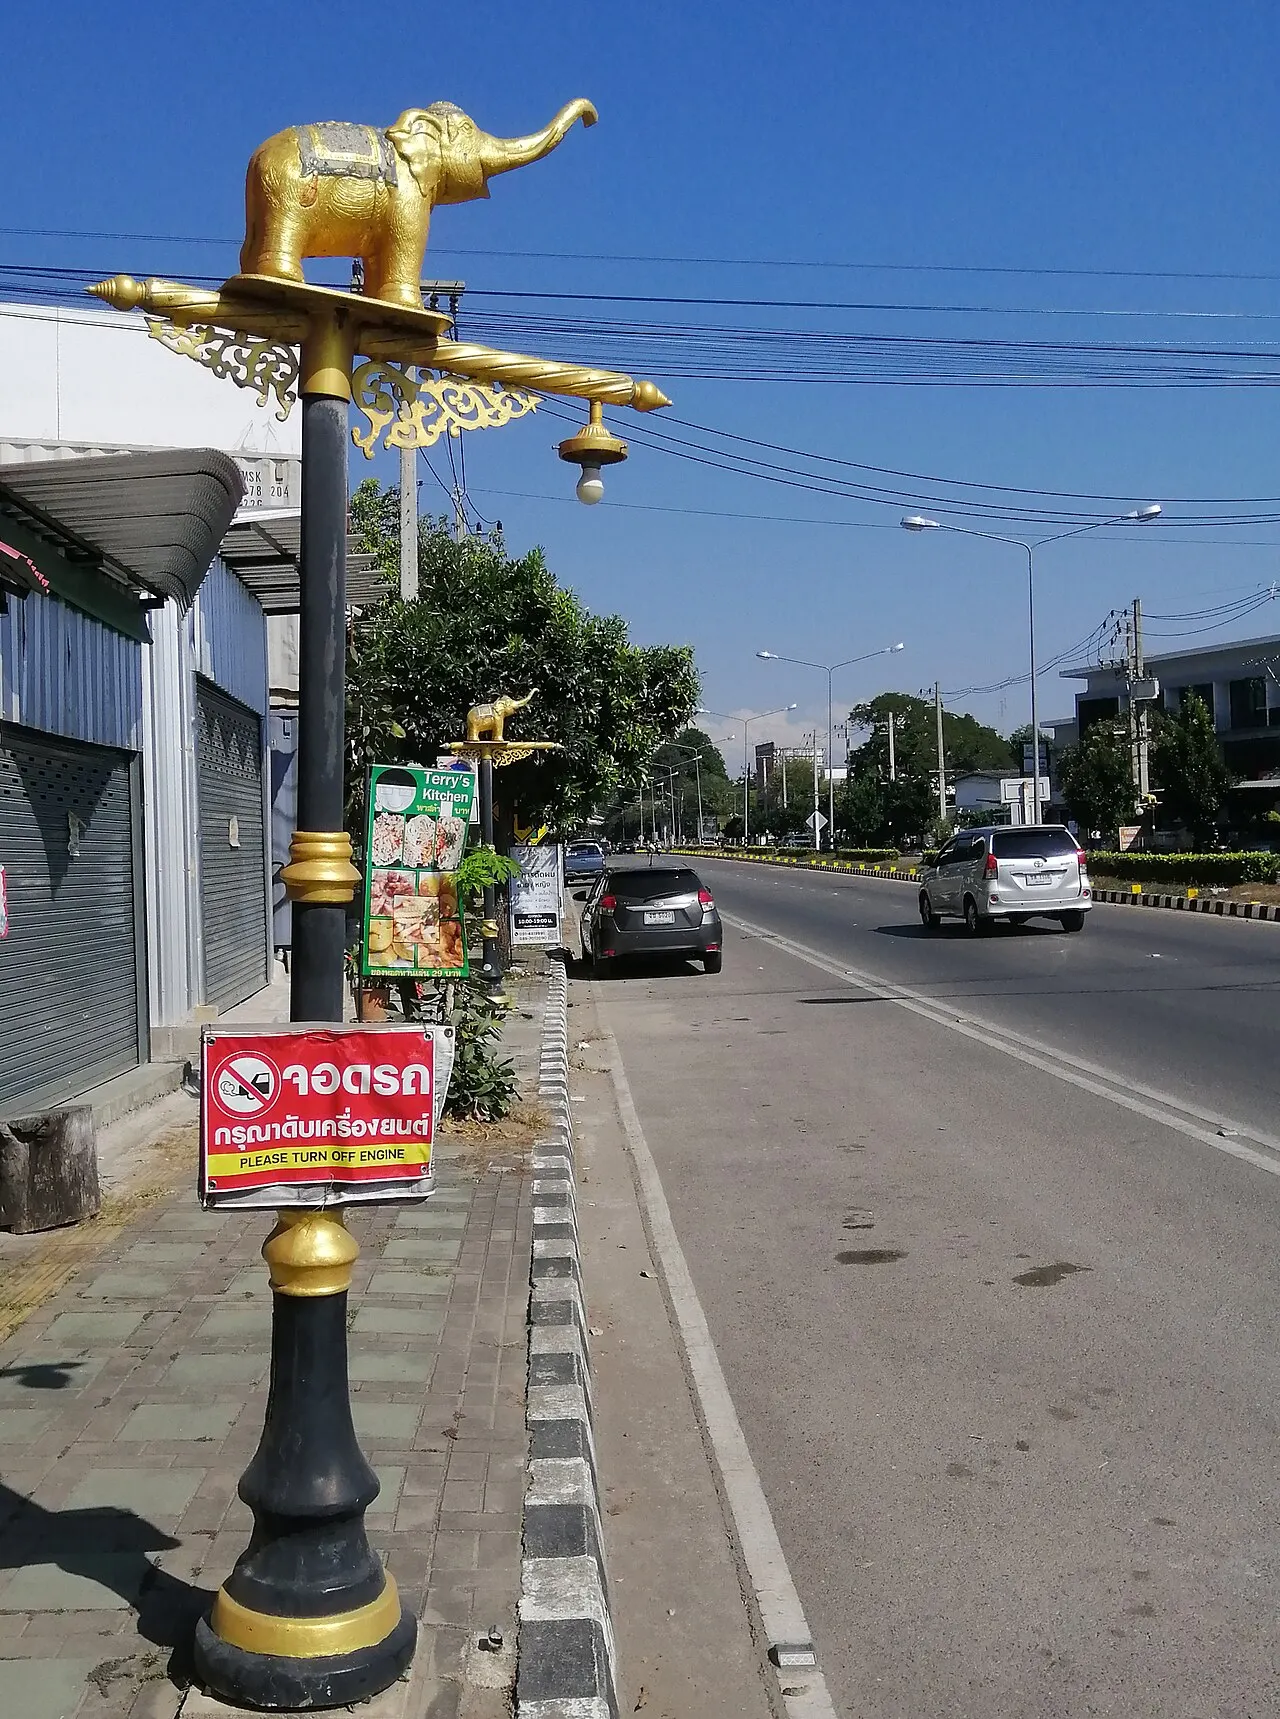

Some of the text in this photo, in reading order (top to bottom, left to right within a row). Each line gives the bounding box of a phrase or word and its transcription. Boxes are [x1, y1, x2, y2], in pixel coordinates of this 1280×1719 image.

[271, 486, 288, 498] 204
[423, 771, 470, 789] Terry's
[422, 788, 469, 803] Kitchen
[432, 969, 443, 977] 29
[444, 969, 461, 977] บาท
[282, 1062, 430, 1096] จอดรถ
[214, 1107, 429, 1151] กรุณาดับเครื่องยนต์
[240, 1148, 405, 1168] PLEASE TURN OFF ENGINE
